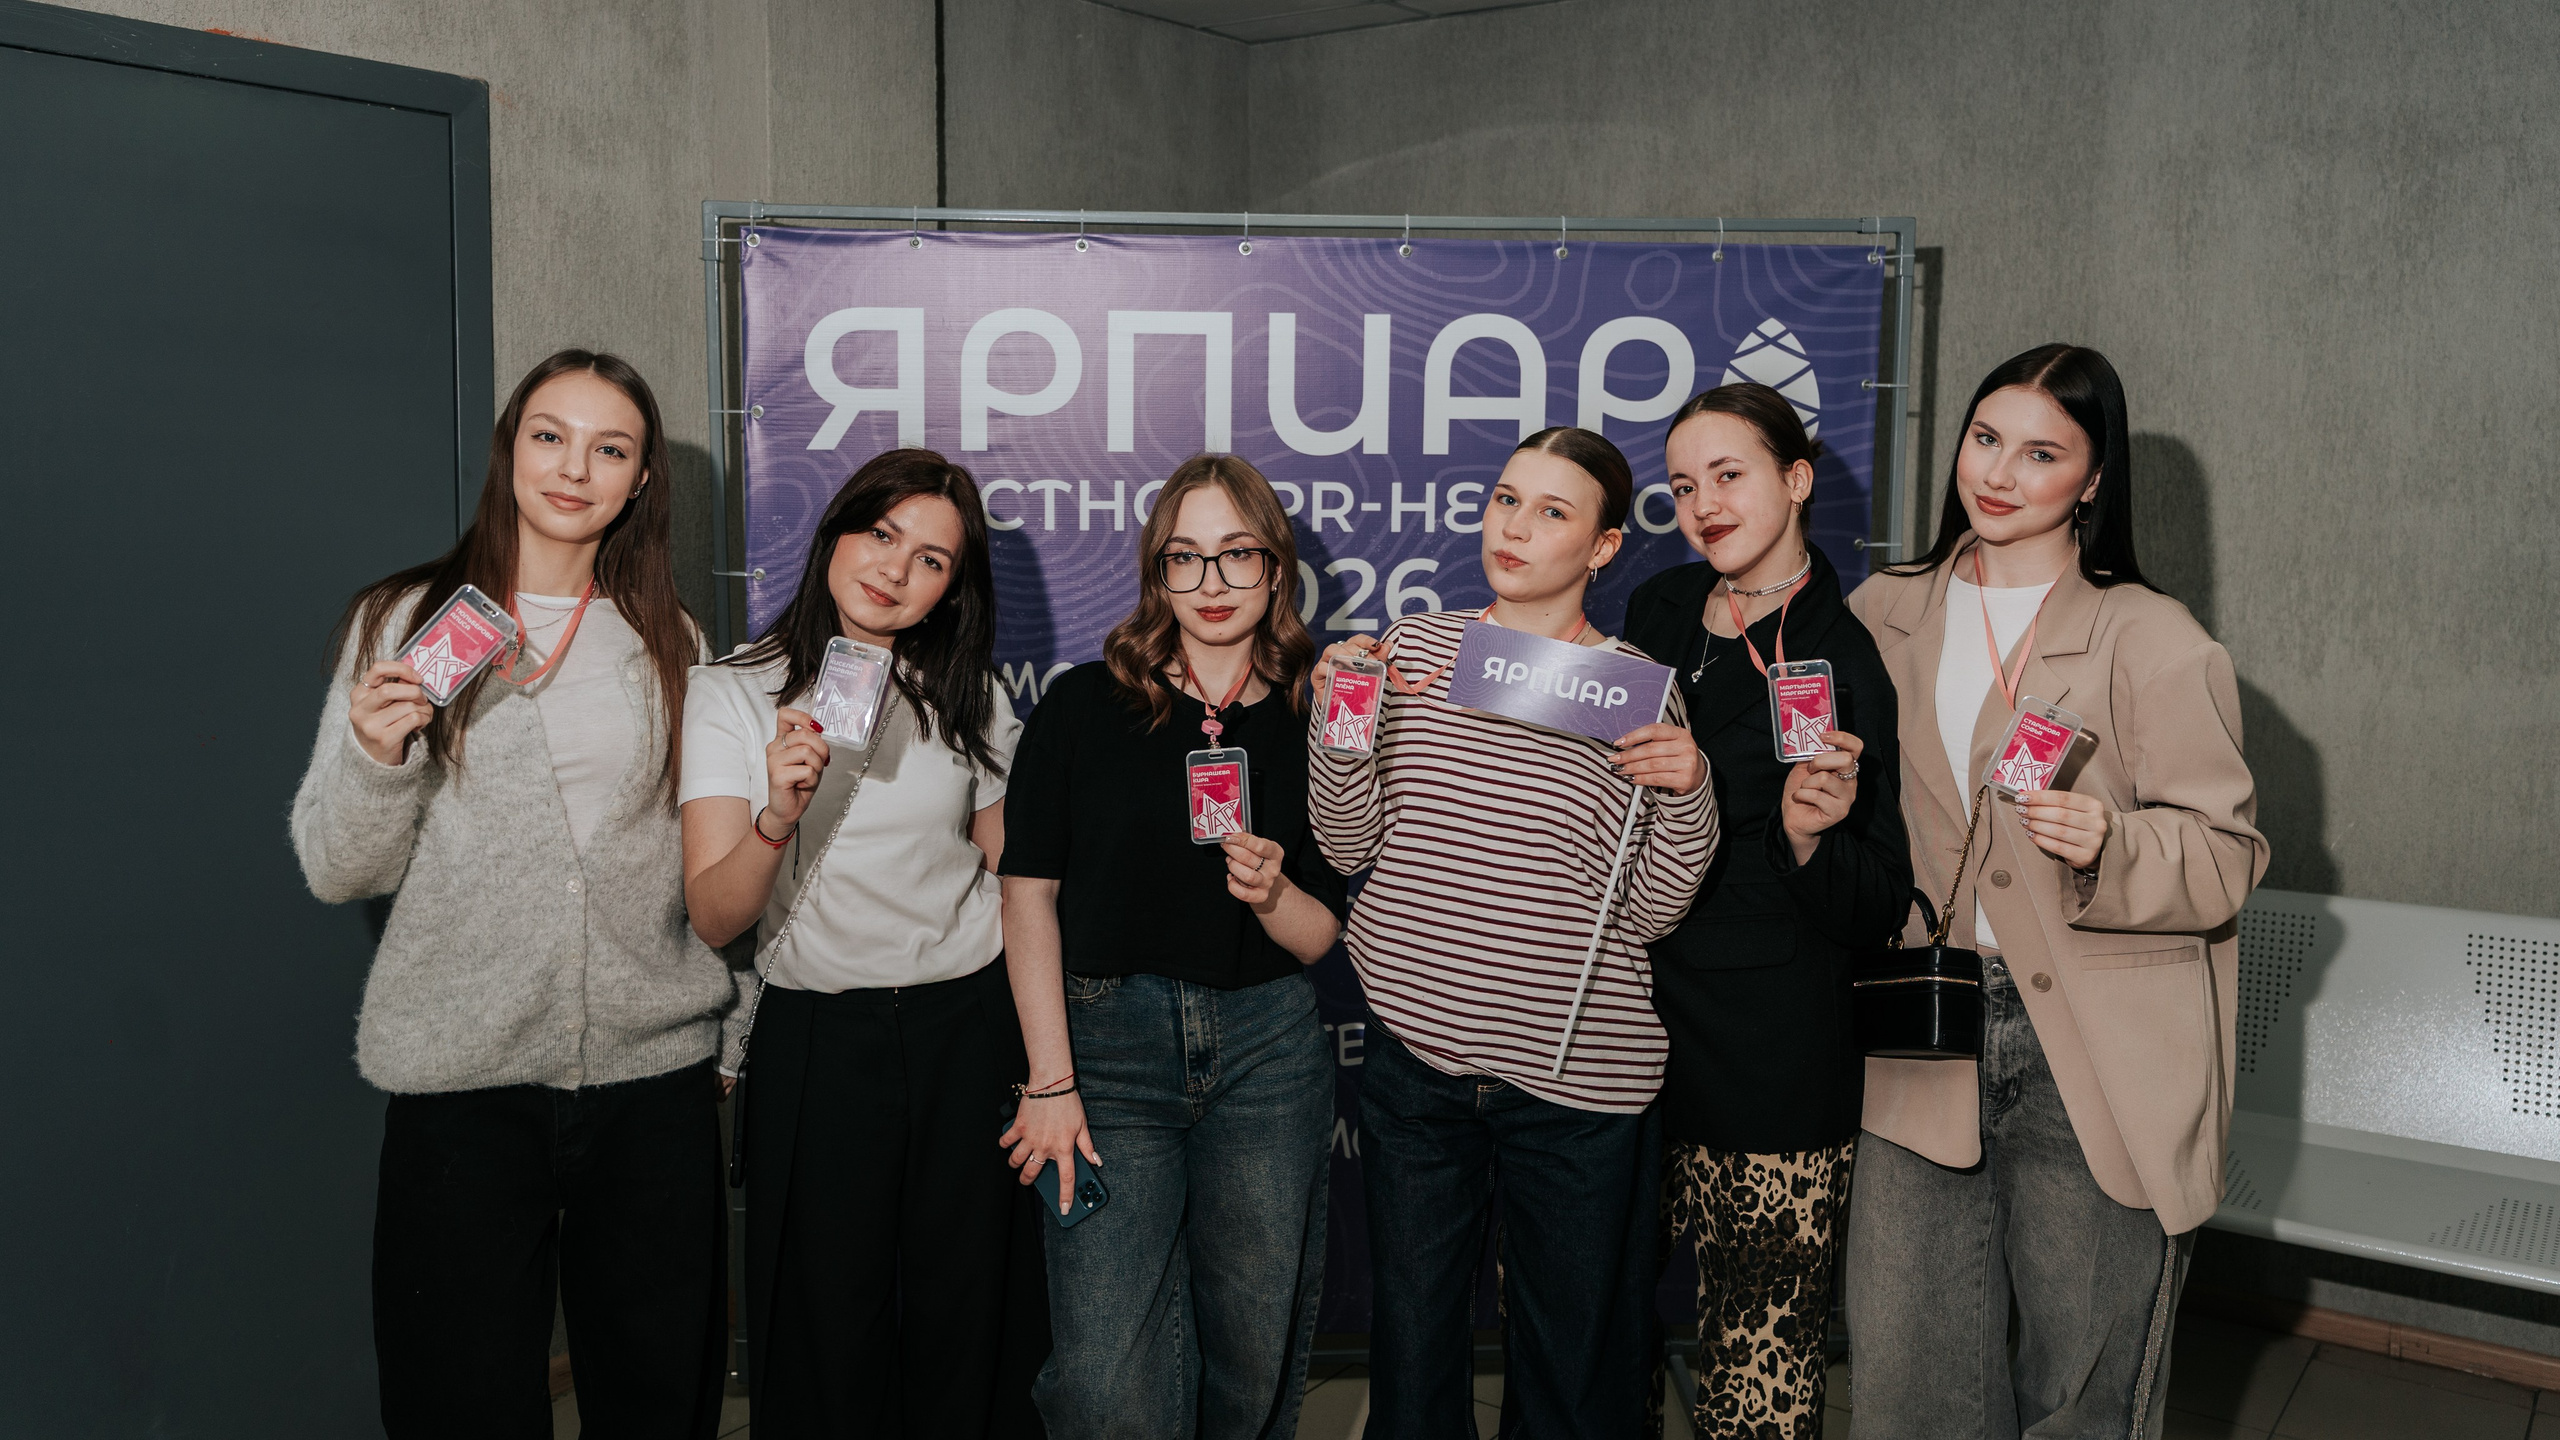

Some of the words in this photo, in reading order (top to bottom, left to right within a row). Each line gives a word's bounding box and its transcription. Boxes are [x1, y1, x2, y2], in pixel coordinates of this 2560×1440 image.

[1297, 558, 1443, 632] 26
[449, 612, 471, 632] АЛИСА
[1780, 688, 1819, 697] МАРГАРИТА
